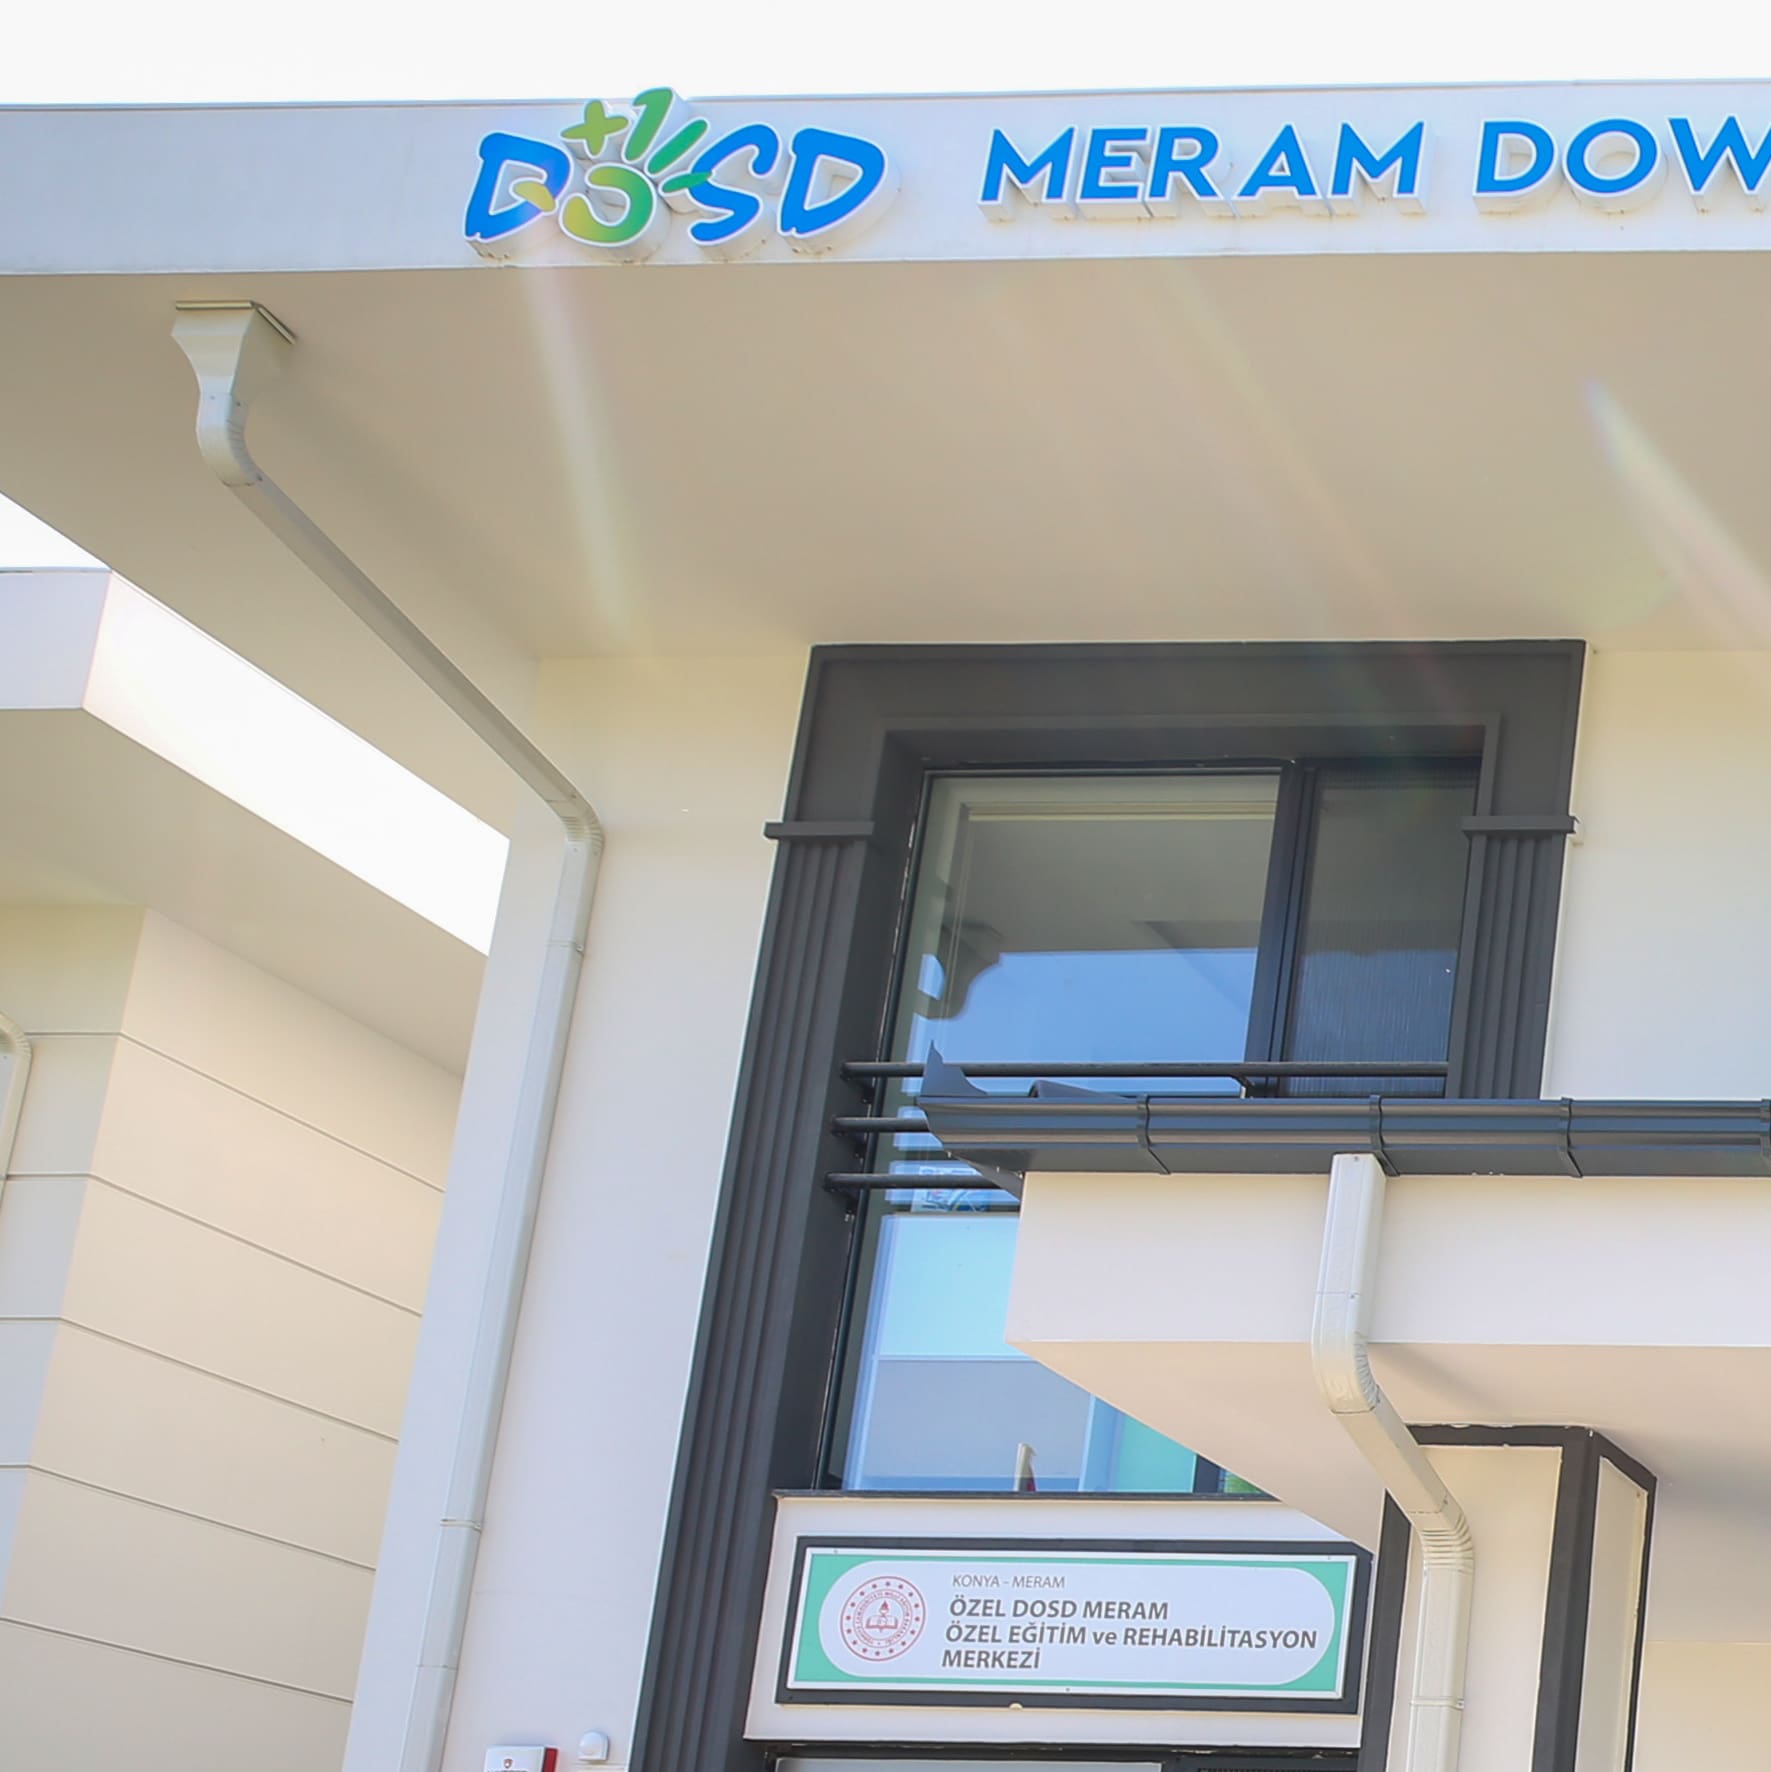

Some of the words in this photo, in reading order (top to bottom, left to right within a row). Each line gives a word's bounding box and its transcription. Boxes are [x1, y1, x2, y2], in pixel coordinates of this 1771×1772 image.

[979, 121, 1426, 202] MERAM
[464, 123, 887, 247] DOSD
[952, 1574, 1001, 1588] KONYA
[1012, 1575, 1066, 1589] MERAM
[950, 1594, 1006, 1618] ÖZEL
[1012, 1599, 1078, 1619] DOSD
[1082, 1600, 1169, 1621] MERAM
[945, 1620, 1003, 1643] ÖZEL
[1008, 1621, 1087, 1645] EĞİTİM
[1092, 1630, 1118, 1646] ve
[1122, 1624, 1318, 1650] REHABİLİTASYON
[941, 1647, 1042, 1670] MERKEZİ
